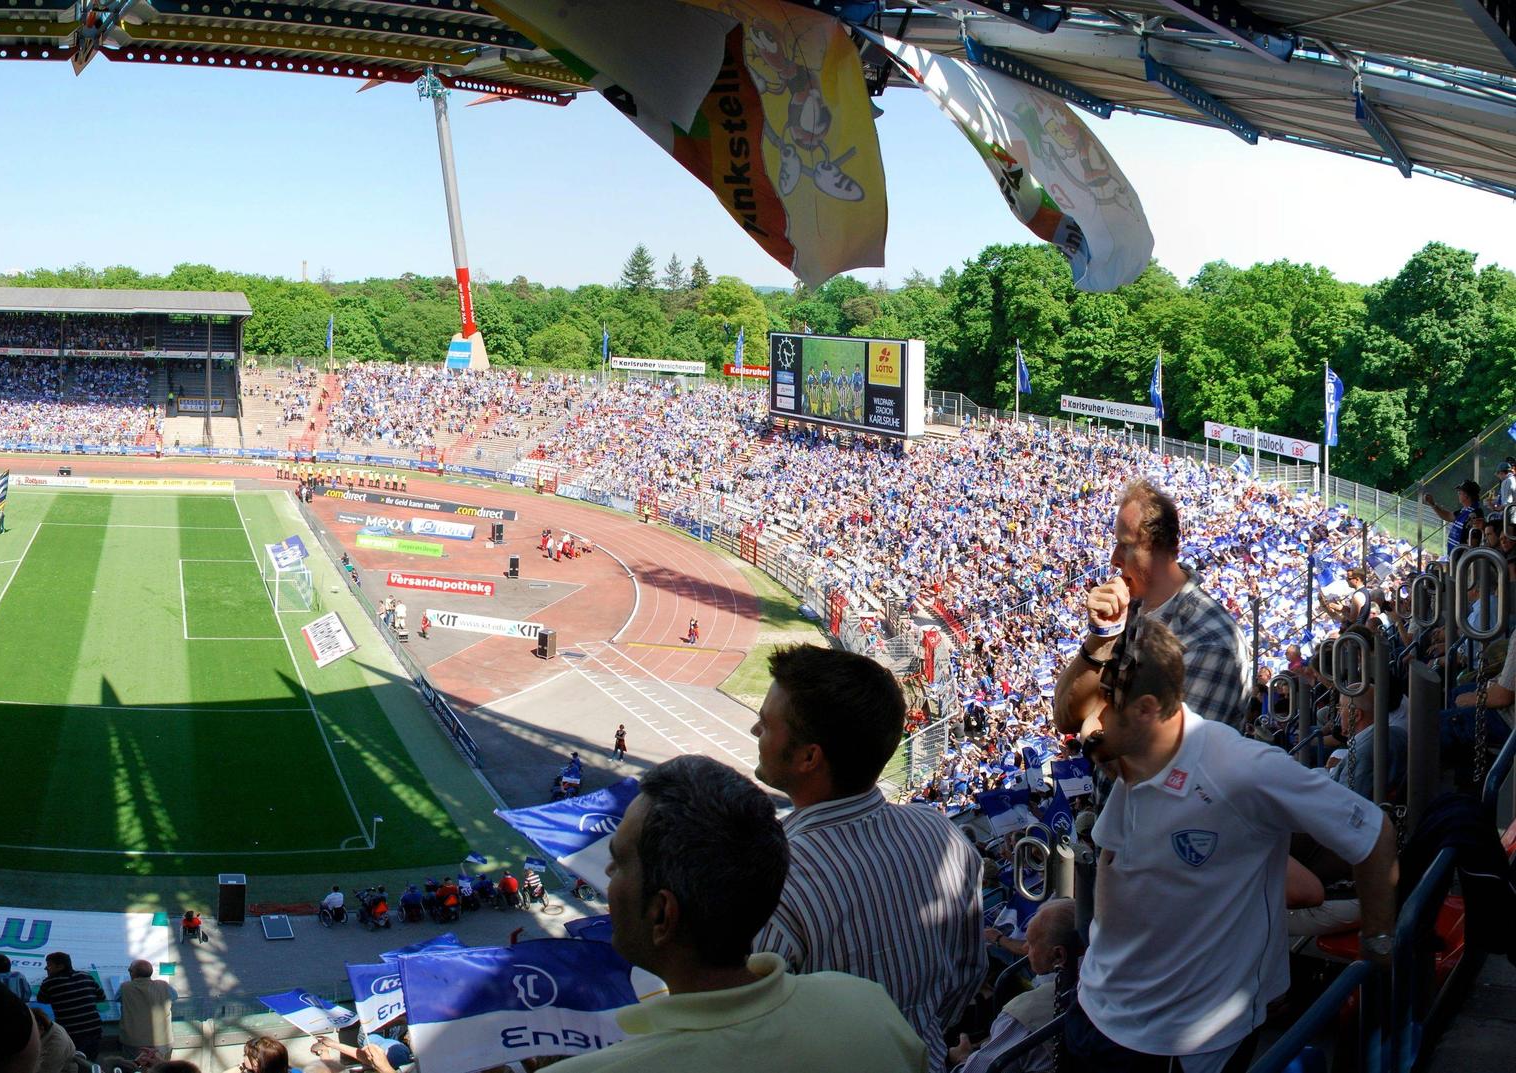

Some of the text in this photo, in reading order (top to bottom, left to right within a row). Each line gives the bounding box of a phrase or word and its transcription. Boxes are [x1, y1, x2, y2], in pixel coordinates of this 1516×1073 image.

[619, 359, 703, 373] Karlsruher Versicherungen
[875, 364, 893, 374] LOTTO
[873, 397, 896, 407] WILDPARK-
[875, 405, 894, 416] STADION
[1068, 400, 1158, 423] Karlsruher Versicherungen
[868, 413, 900, 428] KARLSRUHE
[1211, 429, 1221, 439] LBS
[1232, 428, 1285, 453] Familinblock
[1291, 446, 1304, 457] LBS
[323, 489, 367, 502] .comdirect
[394, 498, 408, 506] Geld
[408, 499, 424, 508] kann
[424, 501, 441, 510] mehr
[454, 506, 504, 520] .comdirect
[436, 612, 459, 627] KIT
[517, 623, 540, 638] KIT
